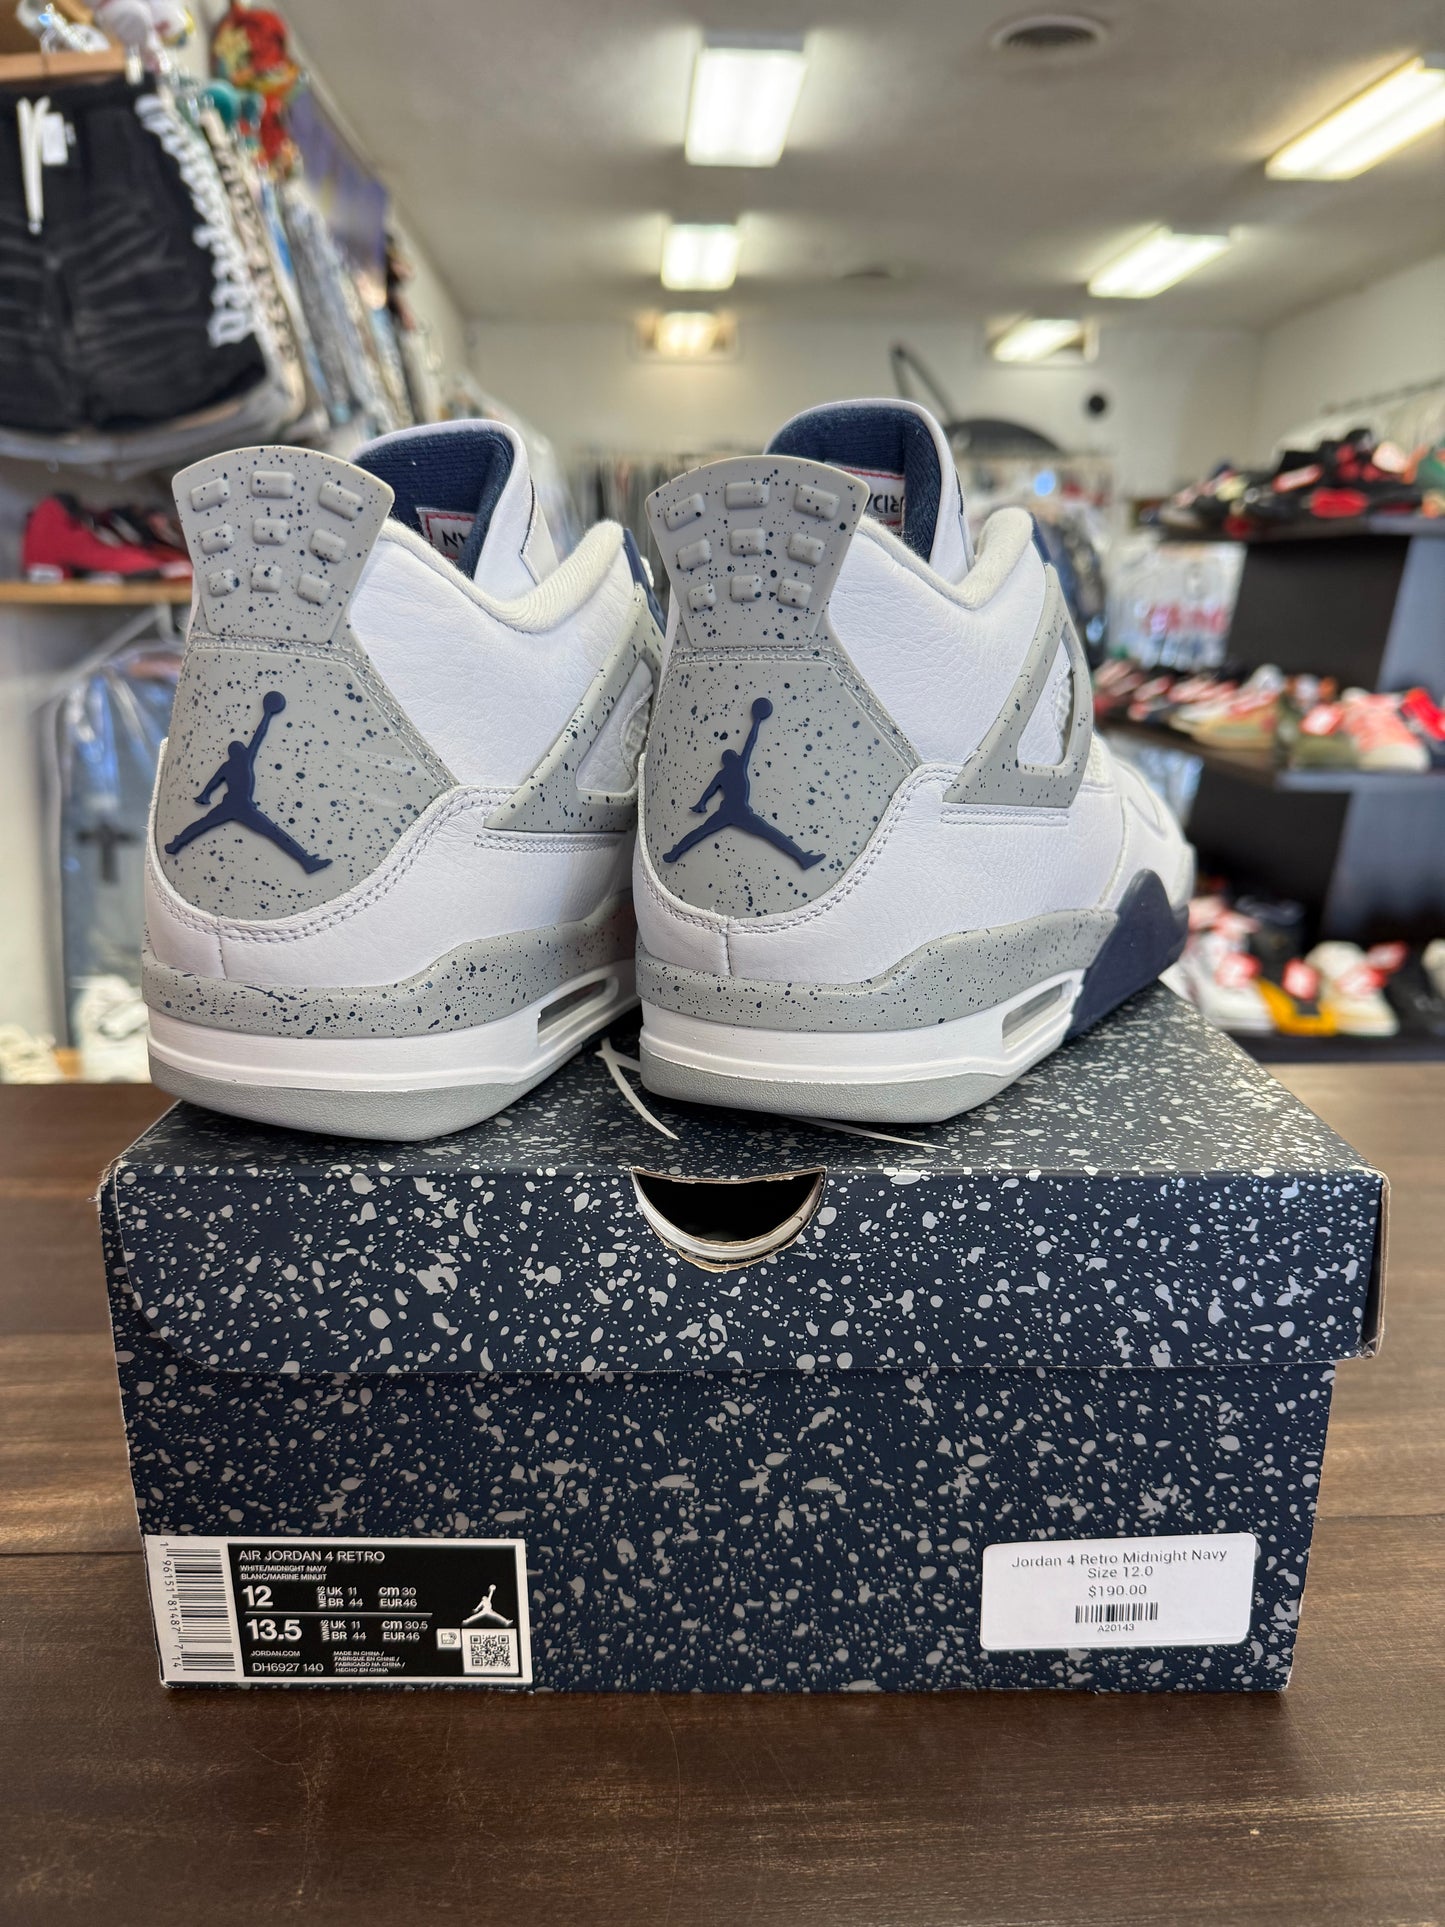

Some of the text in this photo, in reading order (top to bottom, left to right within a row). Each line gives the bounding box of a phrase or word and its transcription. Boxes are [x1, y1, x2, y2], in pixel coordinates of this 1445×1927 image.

[239, 1550, 386, 1563] AIR JORDAN 4 RETRO
[1011, 1549, 1228, 1568] Jordan 4 Retro Midnight Navy
[162, 1560, 175, 1593] 96151
[1087, 1566, 1154, 1578] Size 12.0
[242, 1585, 274, 1607] 12
[317, 1585, 327, 1608] MENS
[326, 1586, 417, 1597] UK 11 cm 30
[1088, 1584, 1147, 1598] $190.00
[328, 1598, 344, 1607] BR
[349, 1598, 364, 1607] 44
[167, 1600, 181, 1632] 81487
[246, 1618, 302, 1641] 13.5
[320, 1619, 330, 1641] WMNS
[330, 1620, 428, 1630] UK 11 cm 30.5
[1097, 1623, 1135, 1633] A20143
[331, 1632, 348, 1640] BR
[352, 1632, 367, 1640] 44
[252, 1662, 324, 1673] DH6927 140
